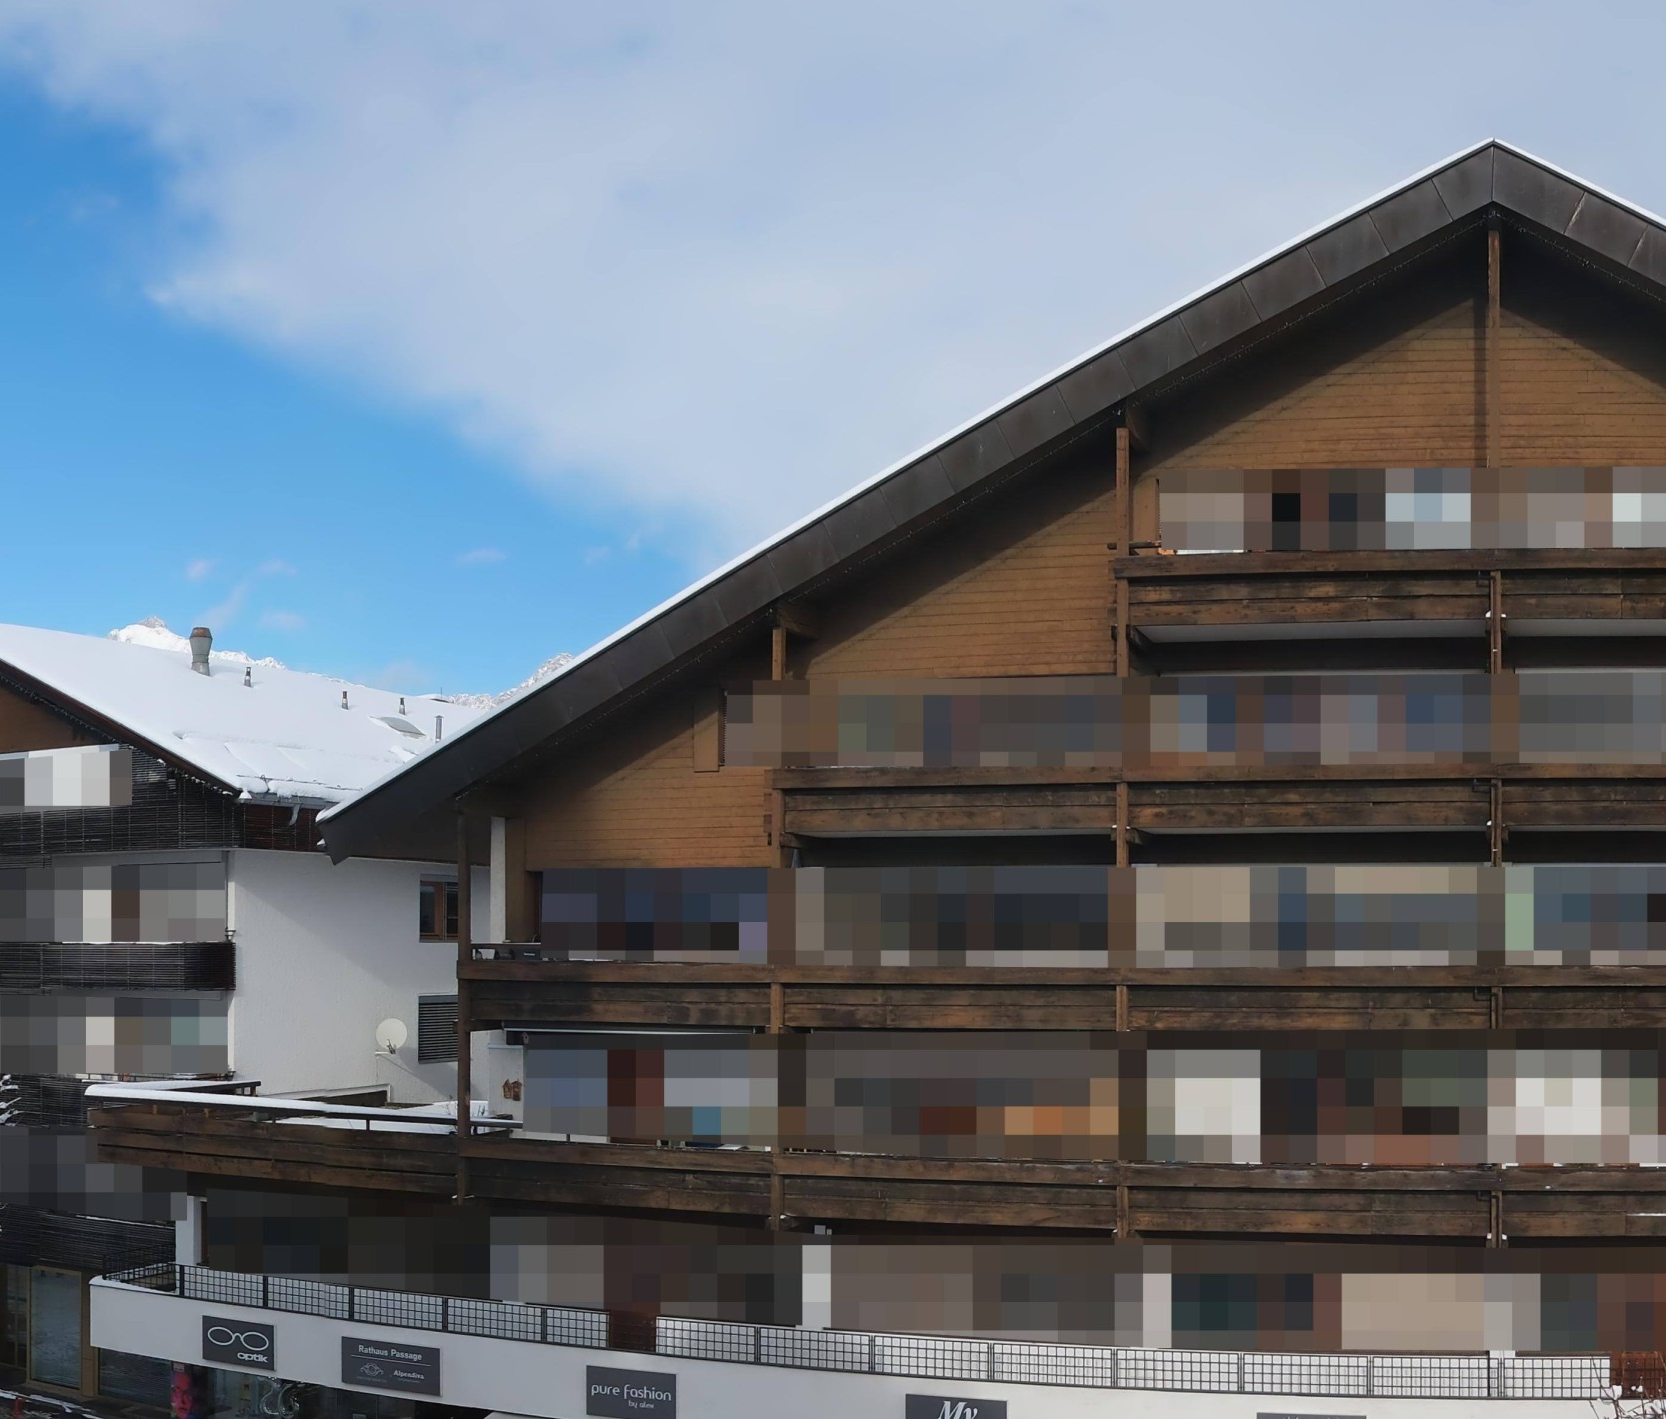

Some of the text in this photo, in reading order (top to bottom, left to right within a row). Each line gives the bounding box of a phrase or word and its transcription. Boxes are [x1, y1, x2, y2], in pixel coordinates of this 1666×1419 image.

[237, 1352, 269, 1363] optik
[358, 1344, 422, 1361] Rathaus Passage
[591, 1384, 672, 1401] pure fashion
[628, 1400, 638, 1409] by
